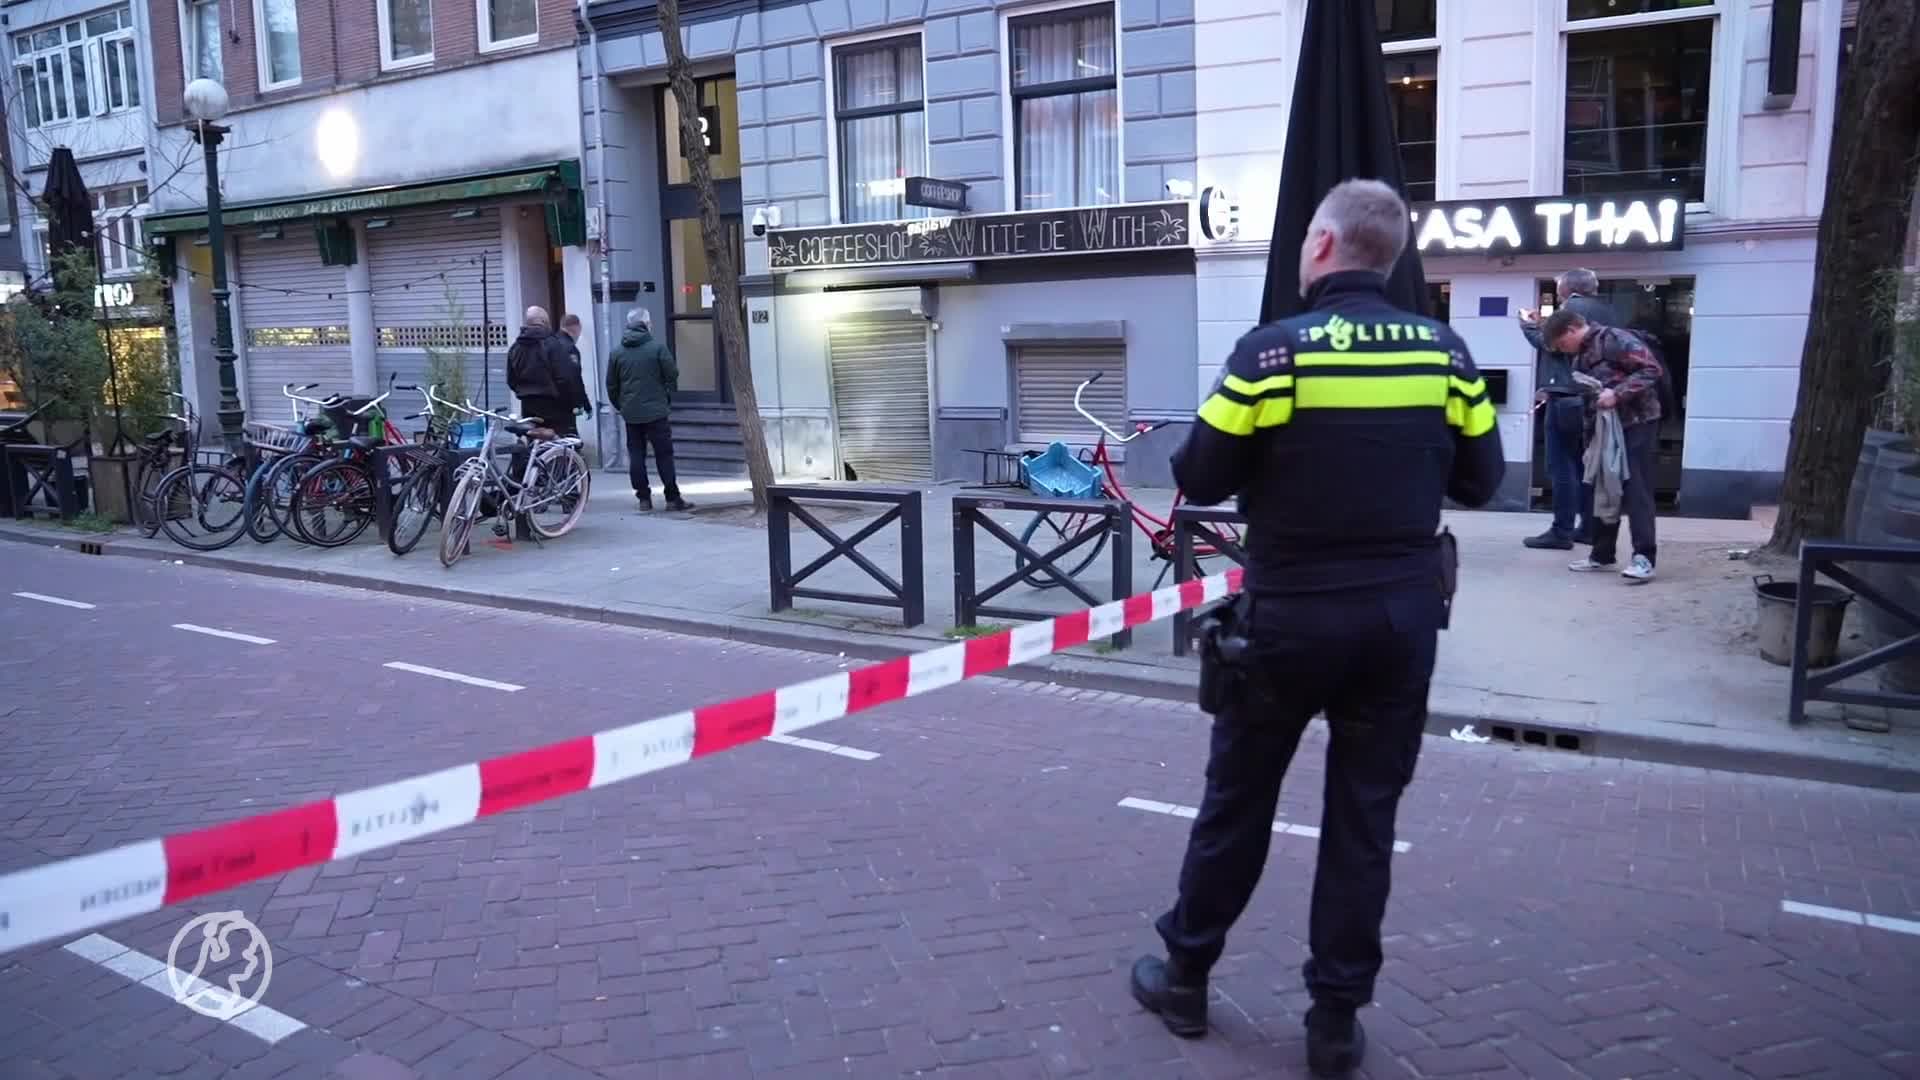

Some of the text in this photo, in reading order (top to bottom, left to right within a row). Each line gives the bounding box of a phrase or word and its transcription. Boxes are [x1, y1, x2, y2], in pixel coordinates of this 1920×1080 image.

[799, 230, 912, 265] COFFEESHOP
[1039, 220, 1066, 251] DE
[1411, 204, 1521, 250] ASA
[1309, 314, 1433, 351] POLITIE
